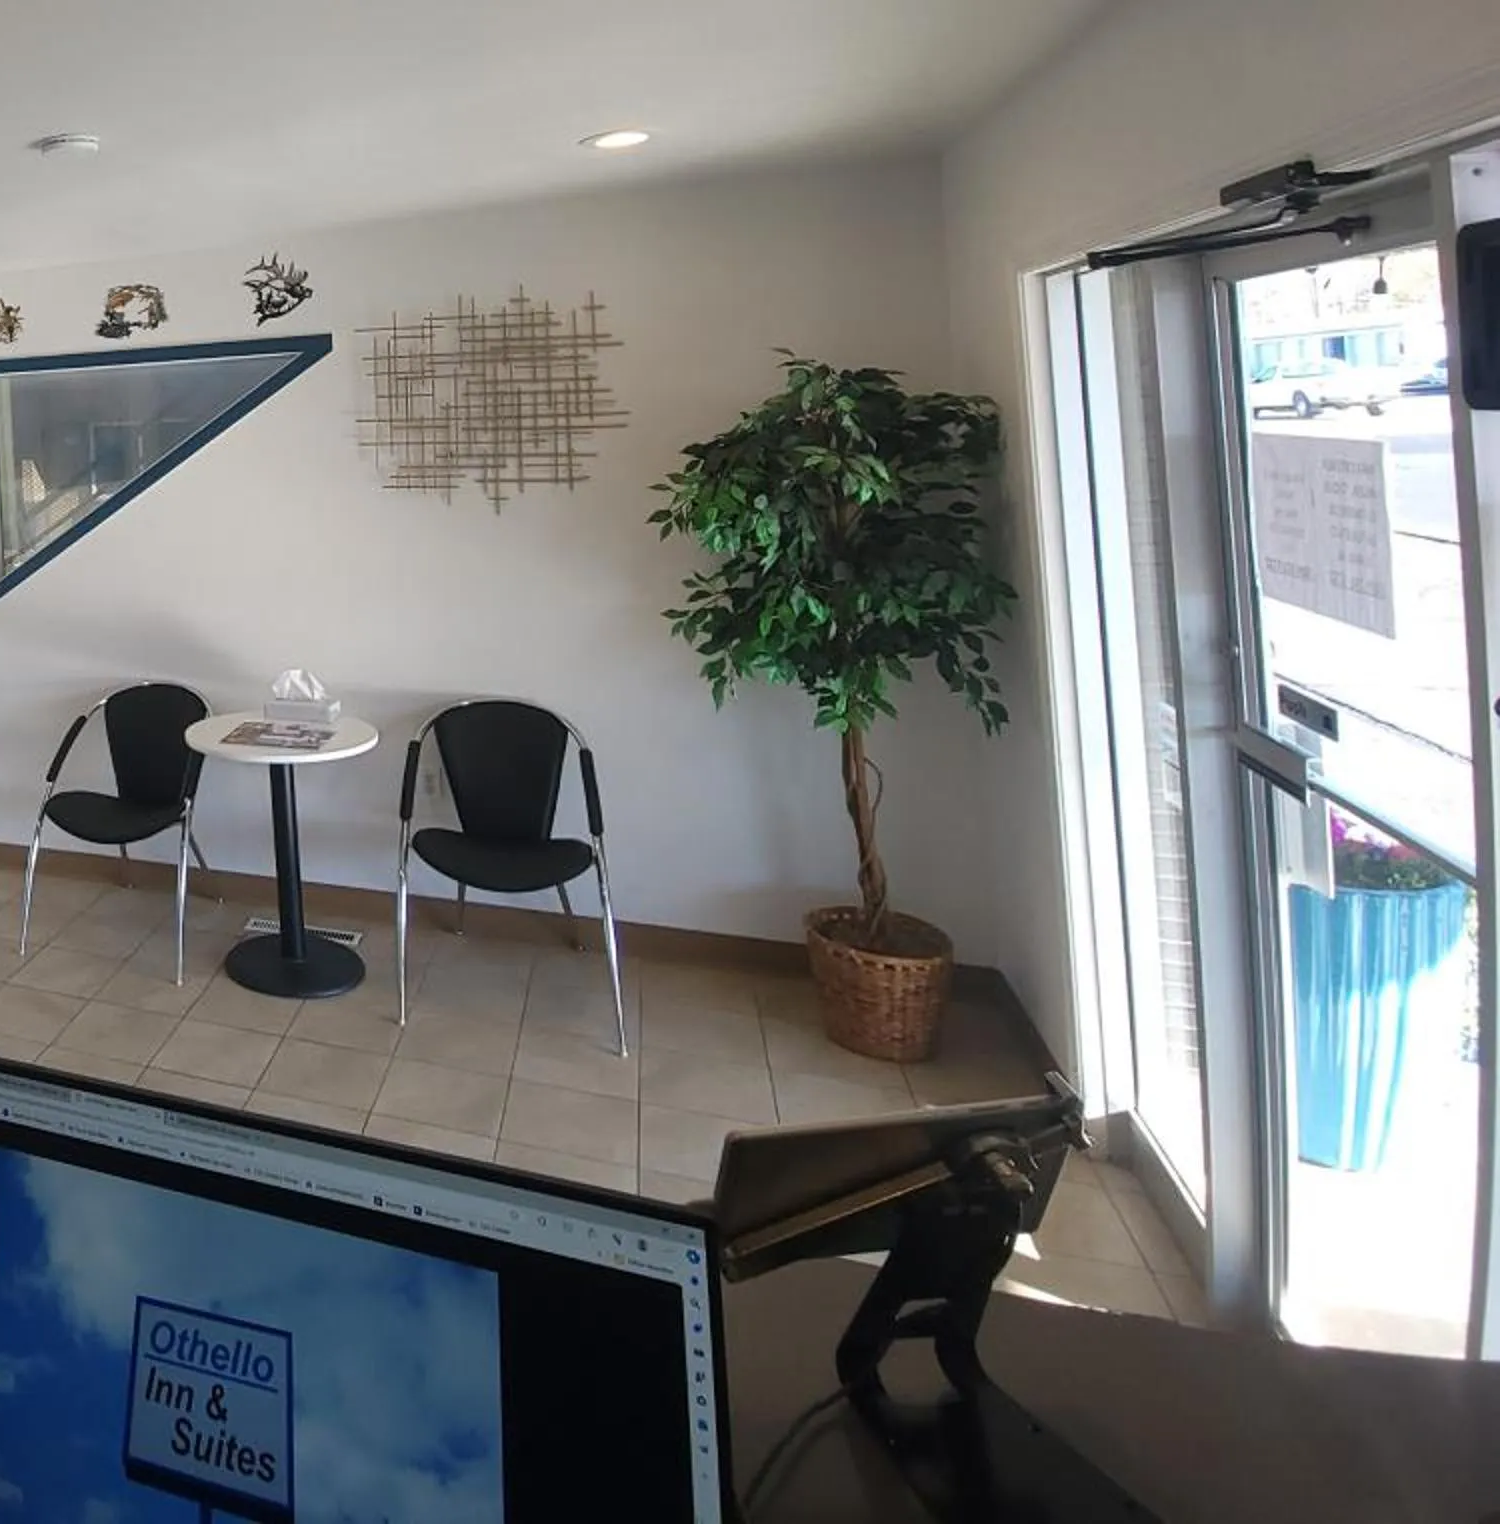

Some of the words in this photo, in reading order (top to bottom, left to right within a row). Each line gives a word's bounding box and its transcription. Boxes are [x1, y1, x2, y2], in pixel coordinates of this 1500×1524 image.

[150, 1320, 275, 1383] Othello
[145, 1366, 195, 1414] Inn
[205, 1383, 229, 1423] &
[171, 1416, 277, 1484] Suites
